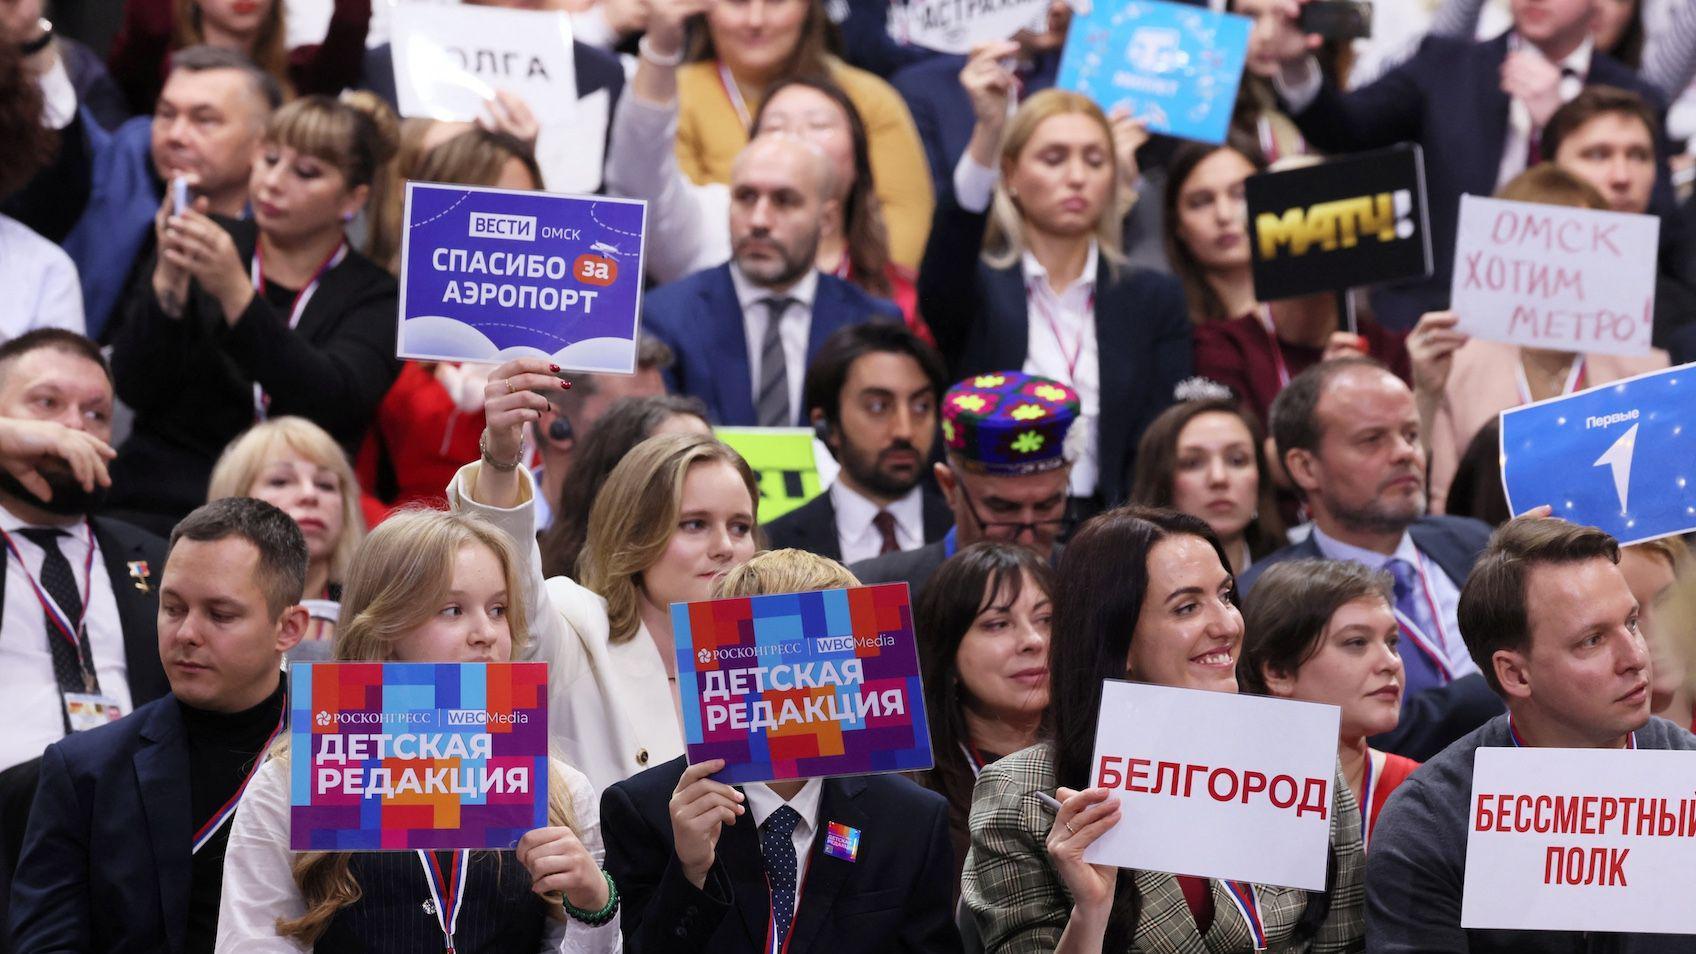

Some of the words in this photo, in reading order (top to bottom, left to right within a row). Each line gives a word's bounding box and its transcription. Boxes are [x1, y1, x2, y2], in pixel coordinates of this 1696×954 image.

[475, 218, 530, 236] ВЕСТИ
[541, 227, 582, 241] ОМСК
[1256, 189, 1415, 260] МАТЧ!
[1491, 210, 1623, 257] ОМСК
[432, 247, 566, 280] СПАСИБО
[581, 260, 609, 280] за
[1463, 251, 1585, 299] ХОТИМ
[442, 280, 598, 314] АЭРОПОРТ
[1586, 409, 1640, 429] Первые
[713, 643, 802, 660] РОСКОНГРЕСС
[817, 634, 895, 652] WBCMedia
[703, 658, 865, 702] ДЕТСКАЯ
[333, 712, 431, 724] РОСКОНГРЕСС
[448, 710, 529, 725] WBCMedia
[706, 688, 905, 733] РЕДАКЦИЯ
[316, 733, 493, 765] ДЕТСКАЯ
[317, 767, 529, 799] РЕДАКЦИЯ
[1097, 755, 1327, 820] БЕЛГОРОД
[1544, 846, 1630, 887] ПОЛК
